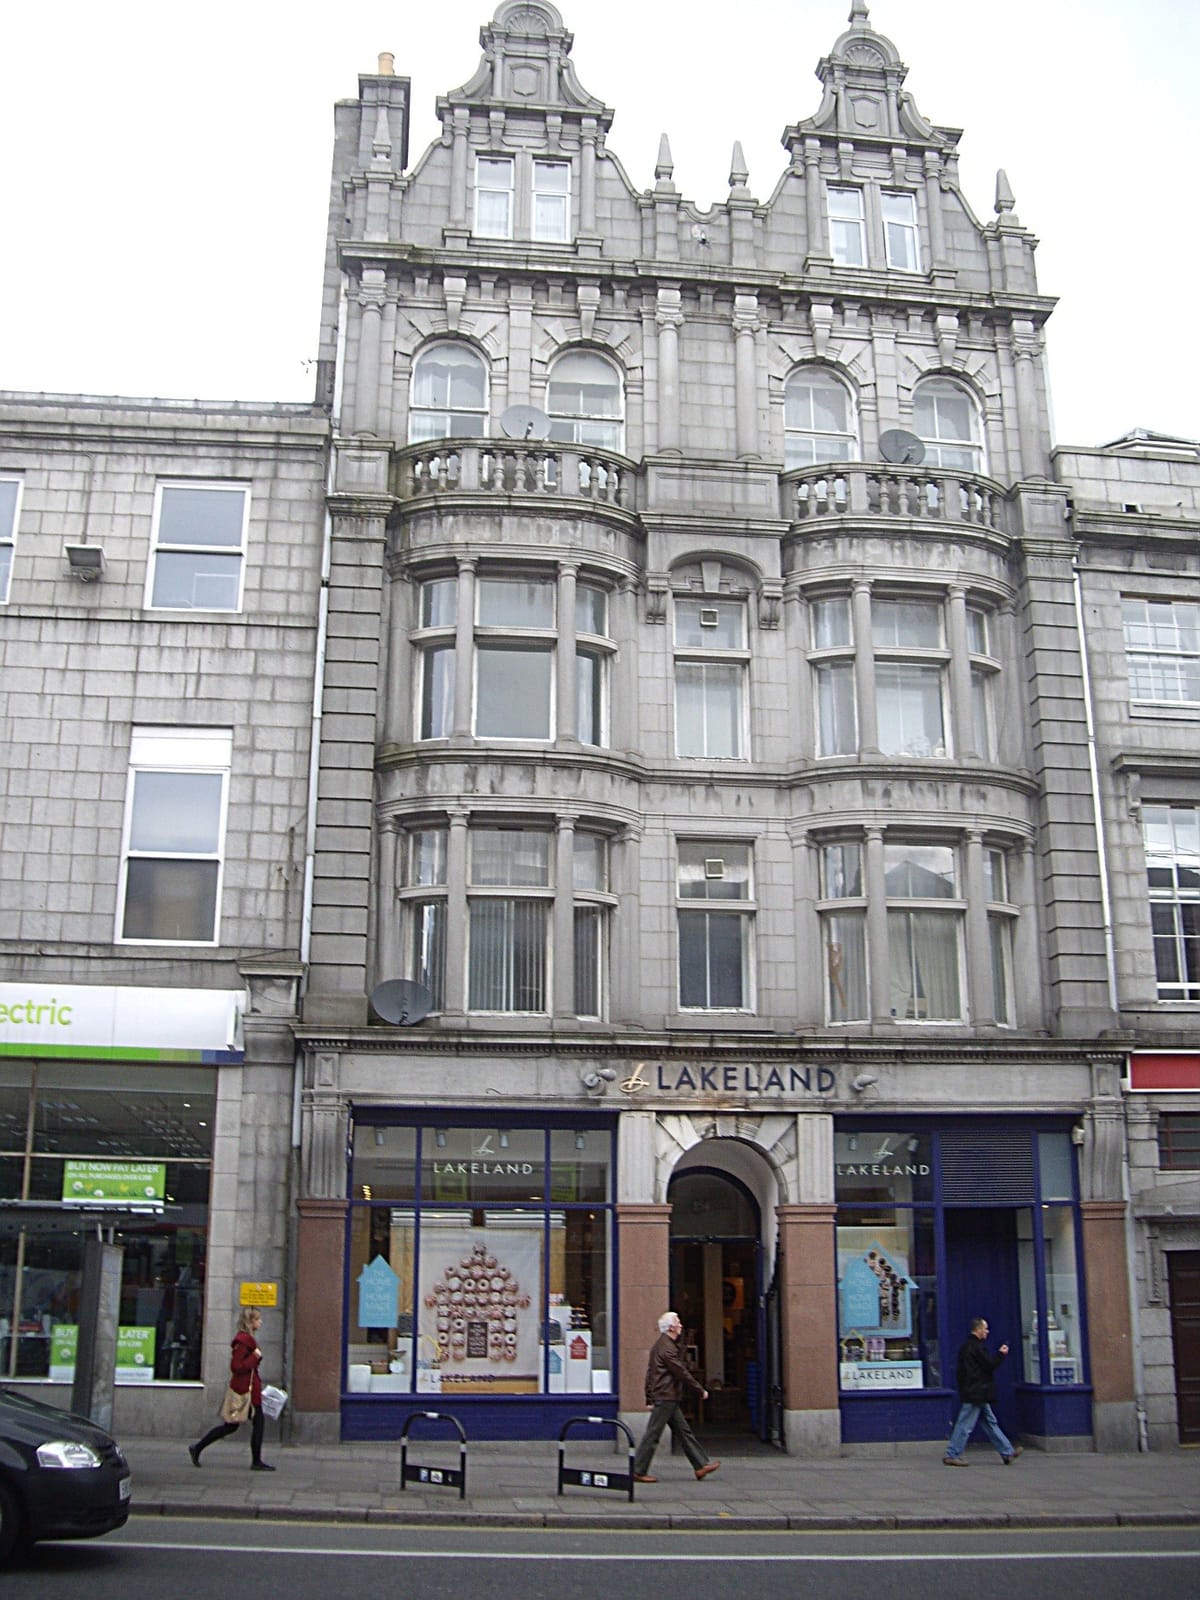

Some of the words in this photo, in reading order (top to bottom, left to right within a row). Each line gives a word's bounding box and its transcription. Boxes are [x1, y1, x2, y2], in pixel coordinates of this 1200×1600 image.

[657, 1065, 836, 1093] LAKELAND
[68, 1162, 87, 1170] BUY
[88, 1162, 113, 1172] NOW
[113, 1163, 130, 1173] PAY
[131, 1164, 160, 1174] LATER
[433, 1161, 533, 1175] LAKELAND
[836, 1164, 930, 1176] LAKELAND
[56, 1328, 74, 1336] BUY
[120, 1330, 150, 1340] LATER
[431, 1373, 497, 1383] LAKELAND
[853, 1369, 914, 1380] LAKELAND
